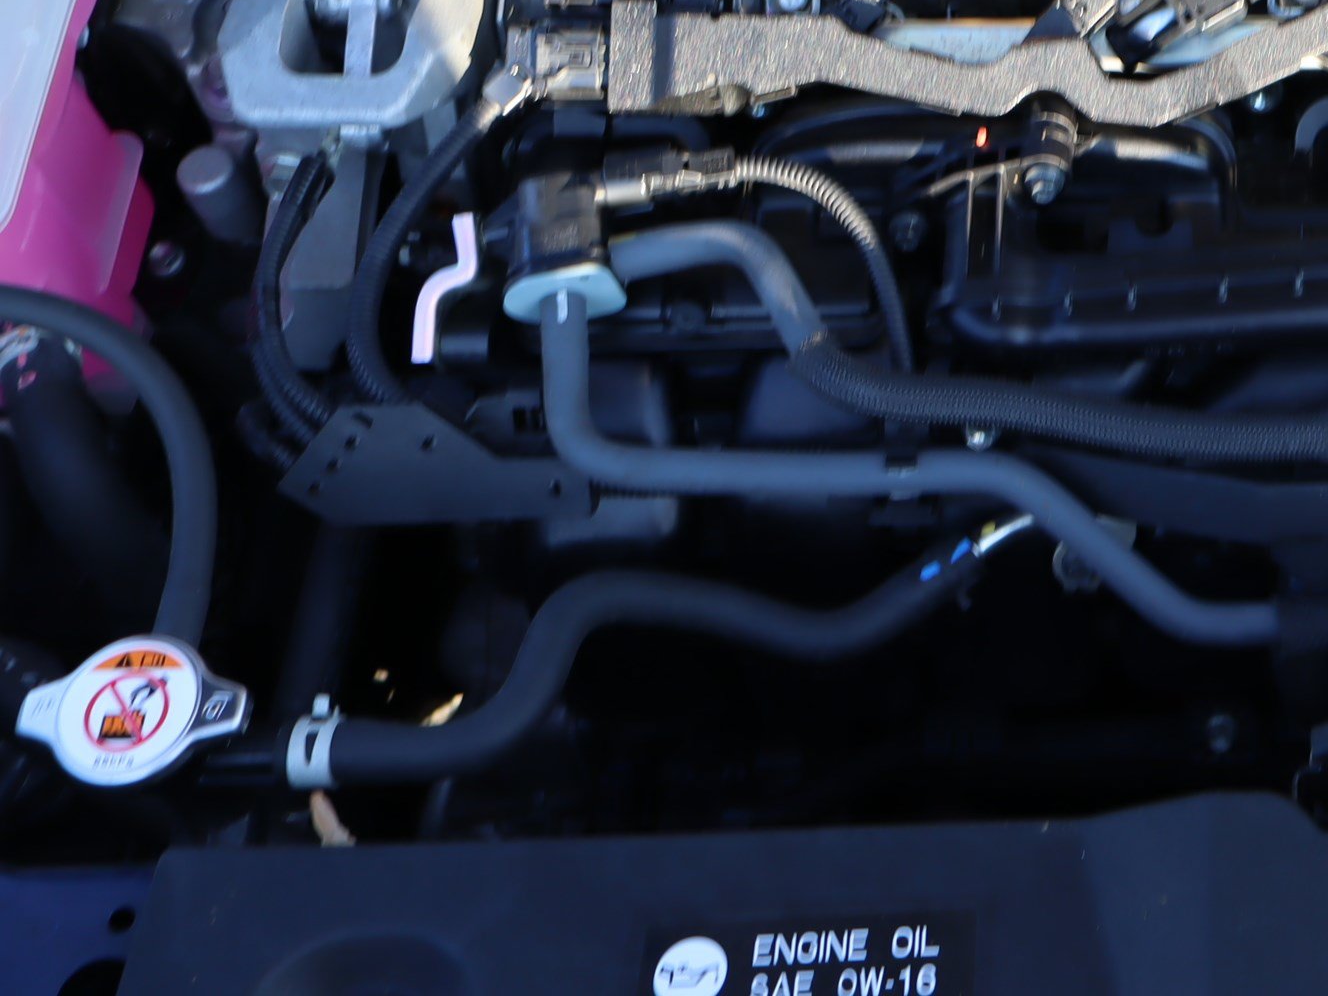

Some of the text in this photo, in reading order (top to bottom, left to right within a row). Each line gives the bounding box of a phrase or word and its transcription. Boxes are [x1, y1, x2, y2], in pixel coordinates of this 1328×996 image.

[752, 925, 939, 967] ENGINE OIL
[750, 970, 815, 996] SAE
